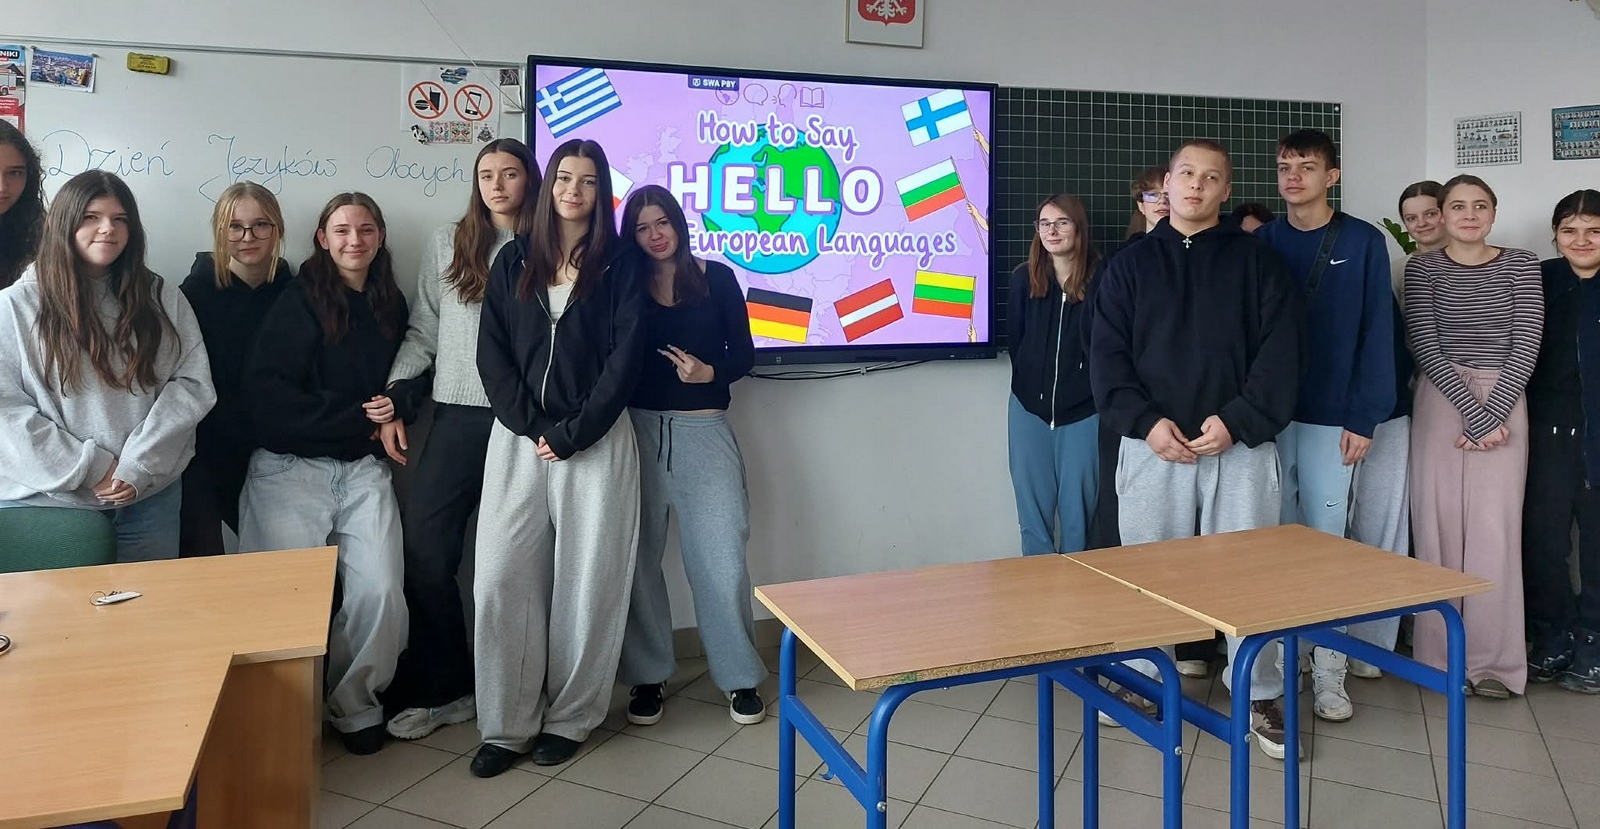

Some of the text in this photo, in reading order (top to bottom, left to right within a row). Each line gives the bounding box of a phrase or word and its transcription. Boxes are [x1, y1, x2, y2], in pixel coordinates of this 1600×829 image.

[699, 112, 858, 161] How to Say
[43, 130, 174, 176] Dzień
[366, 146, 475, 197] Obcych
[668, 161, 883, 216] HELLO
[817, 225, 956, 268] Languages
